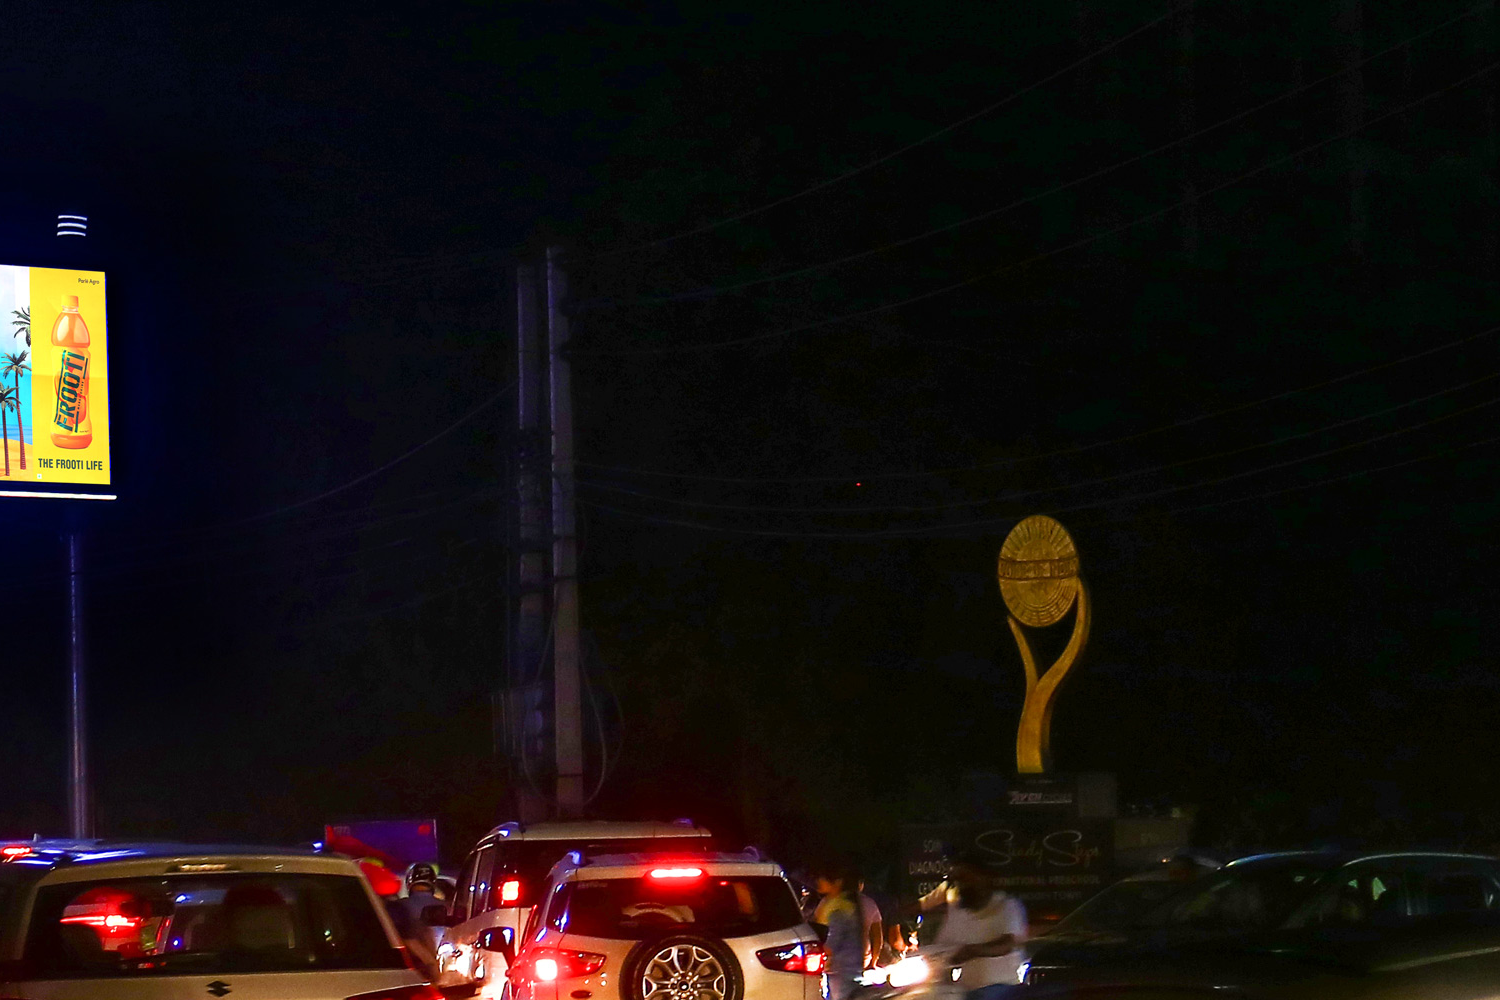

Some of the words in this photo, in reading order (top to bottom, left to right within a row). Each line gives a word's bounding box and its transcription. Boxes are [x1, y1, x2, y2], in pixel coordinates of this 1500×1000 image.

[57, 351, 85, 432] FROOTI
[38, 458, 53, 468] THE
[56, 459, 84, 470] FROOTI
[86, 460, 103, 471] LIFE
